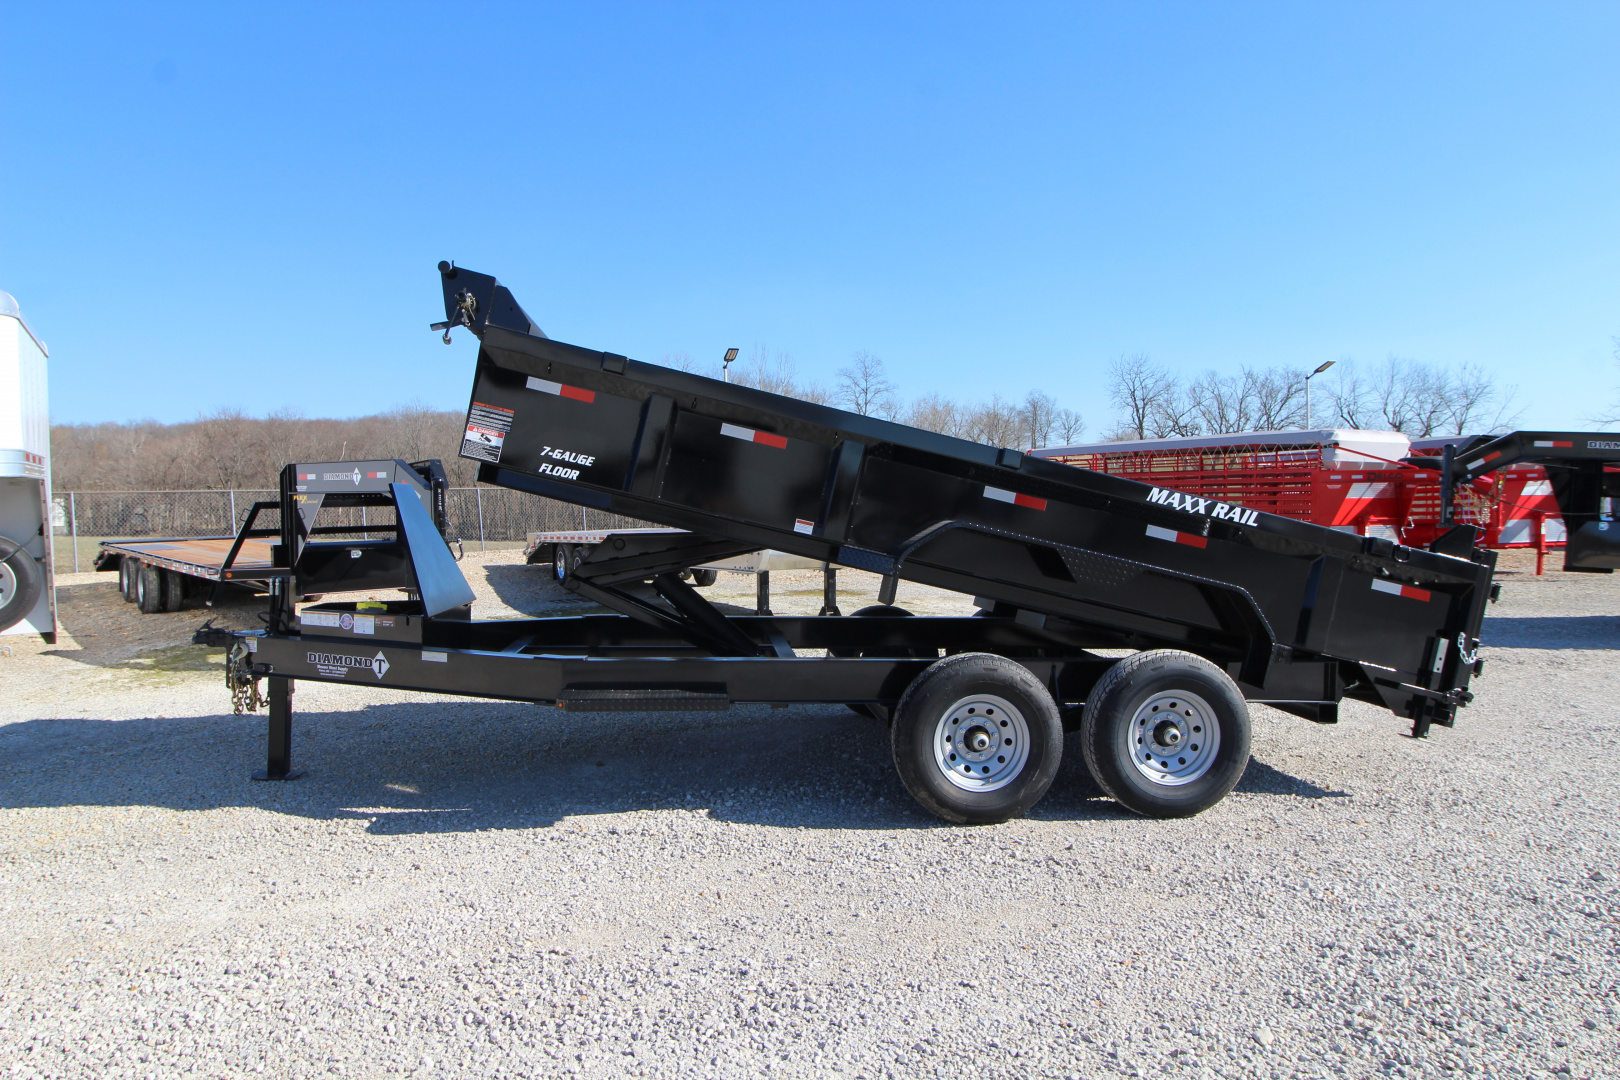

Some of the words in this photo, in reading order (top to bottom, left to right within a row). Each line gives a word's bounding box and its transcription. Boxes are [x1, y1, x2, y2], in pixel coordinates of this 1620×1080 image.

[540, 445, 596, 467] 7-GAUGE
[323, 472, 354, 481] DIAMOND
[538, 462, 580, 481] FLOOR
[1146, 486, 1212, 515] MAXX
[1210, 502, 1259, 527] RAIL
[307, 651, 374, 669] DIAMOND
